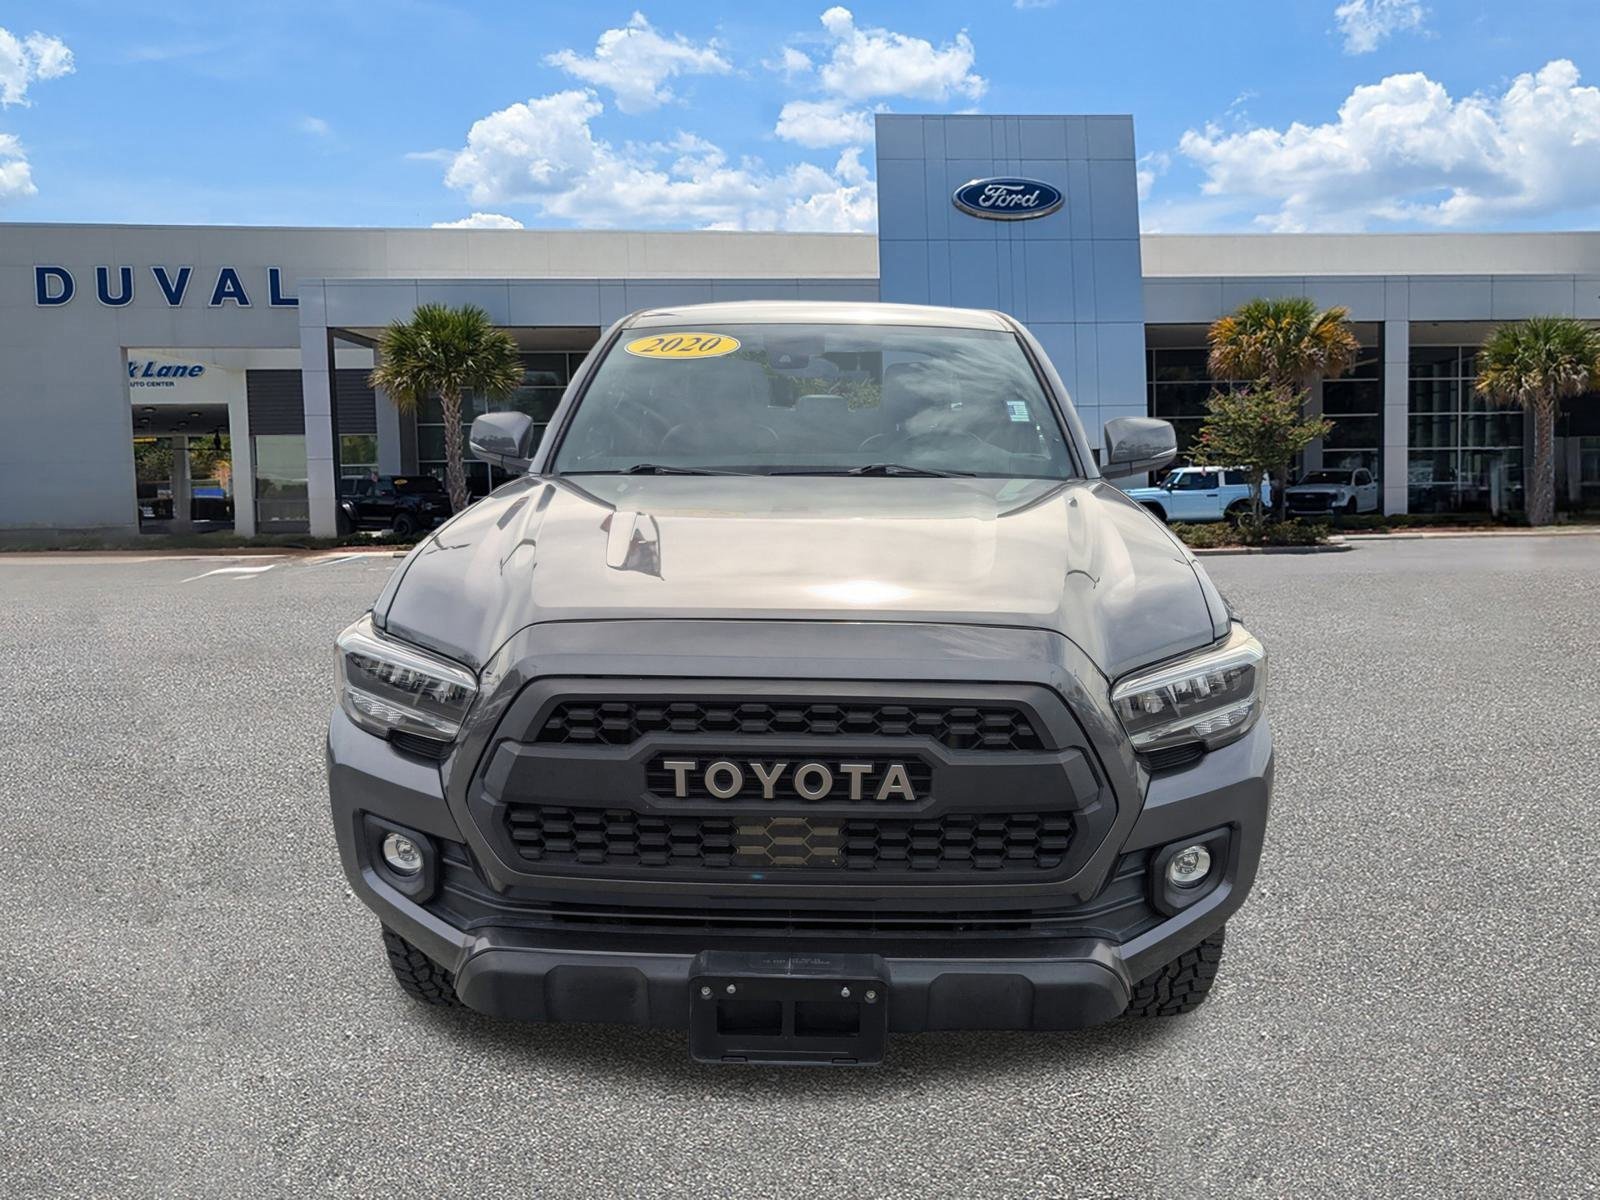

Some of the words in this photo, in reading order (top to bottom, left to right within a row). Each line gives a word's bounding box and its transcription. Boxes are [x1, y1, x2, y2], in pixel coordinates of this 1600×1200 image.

[979, 184, 1040, 207] Ford
[34, 266, 299, 307] DUVAL
[641, 337, 722, 353] 2020
[142, 361, 204, 378] Lane
[664, 760, 916, 800] TOYOTA
